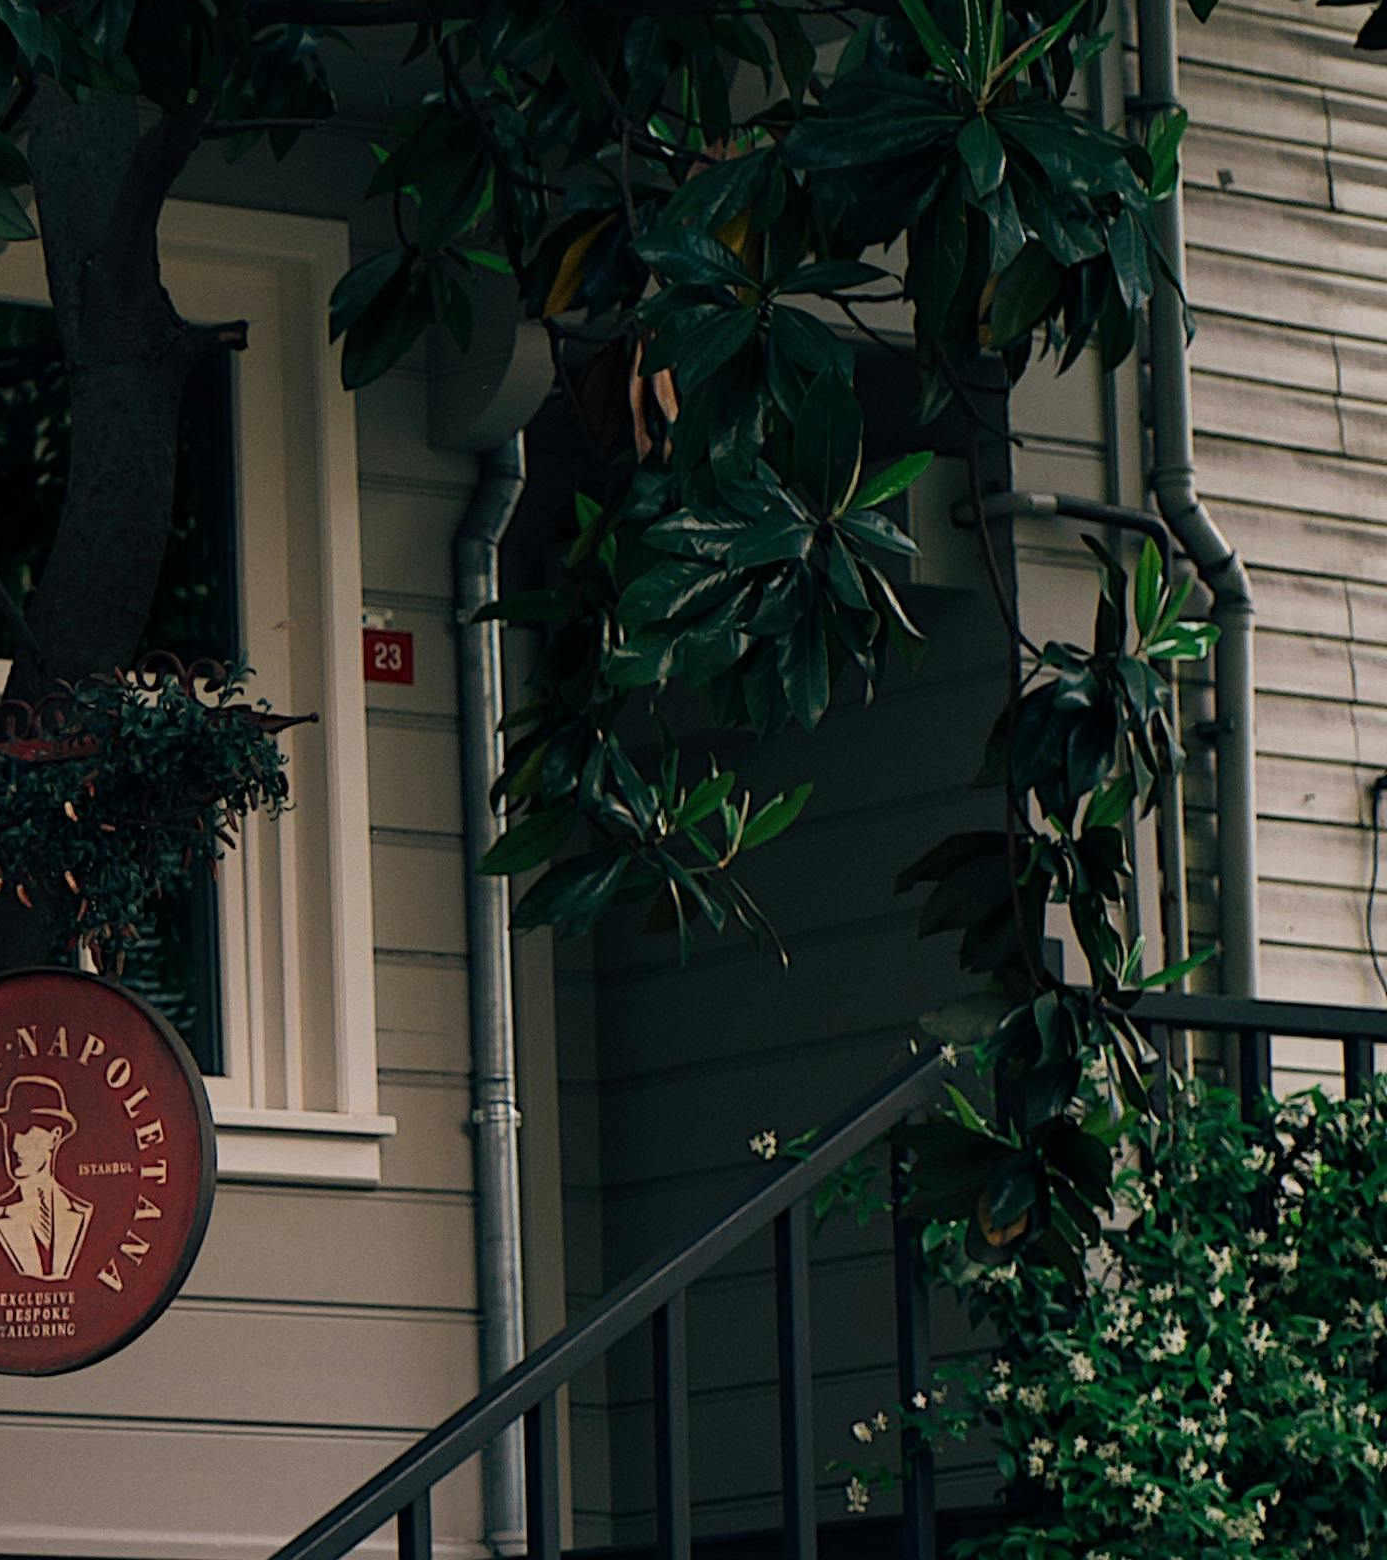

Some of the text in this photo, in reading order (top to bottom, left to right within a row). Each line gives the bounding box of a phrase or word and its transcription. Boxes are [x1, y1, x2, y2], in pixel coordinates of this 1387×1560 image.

[374, 642, 402, 672] 23
[14, 1024, 168, 1297] NAPOLETANA
[78, 1162, 134, 1177] ISTANBUL
[0, 1291, 76, 1306] EXCLUSIVE
[5, 1307, 70, 1323] BESPOKE
